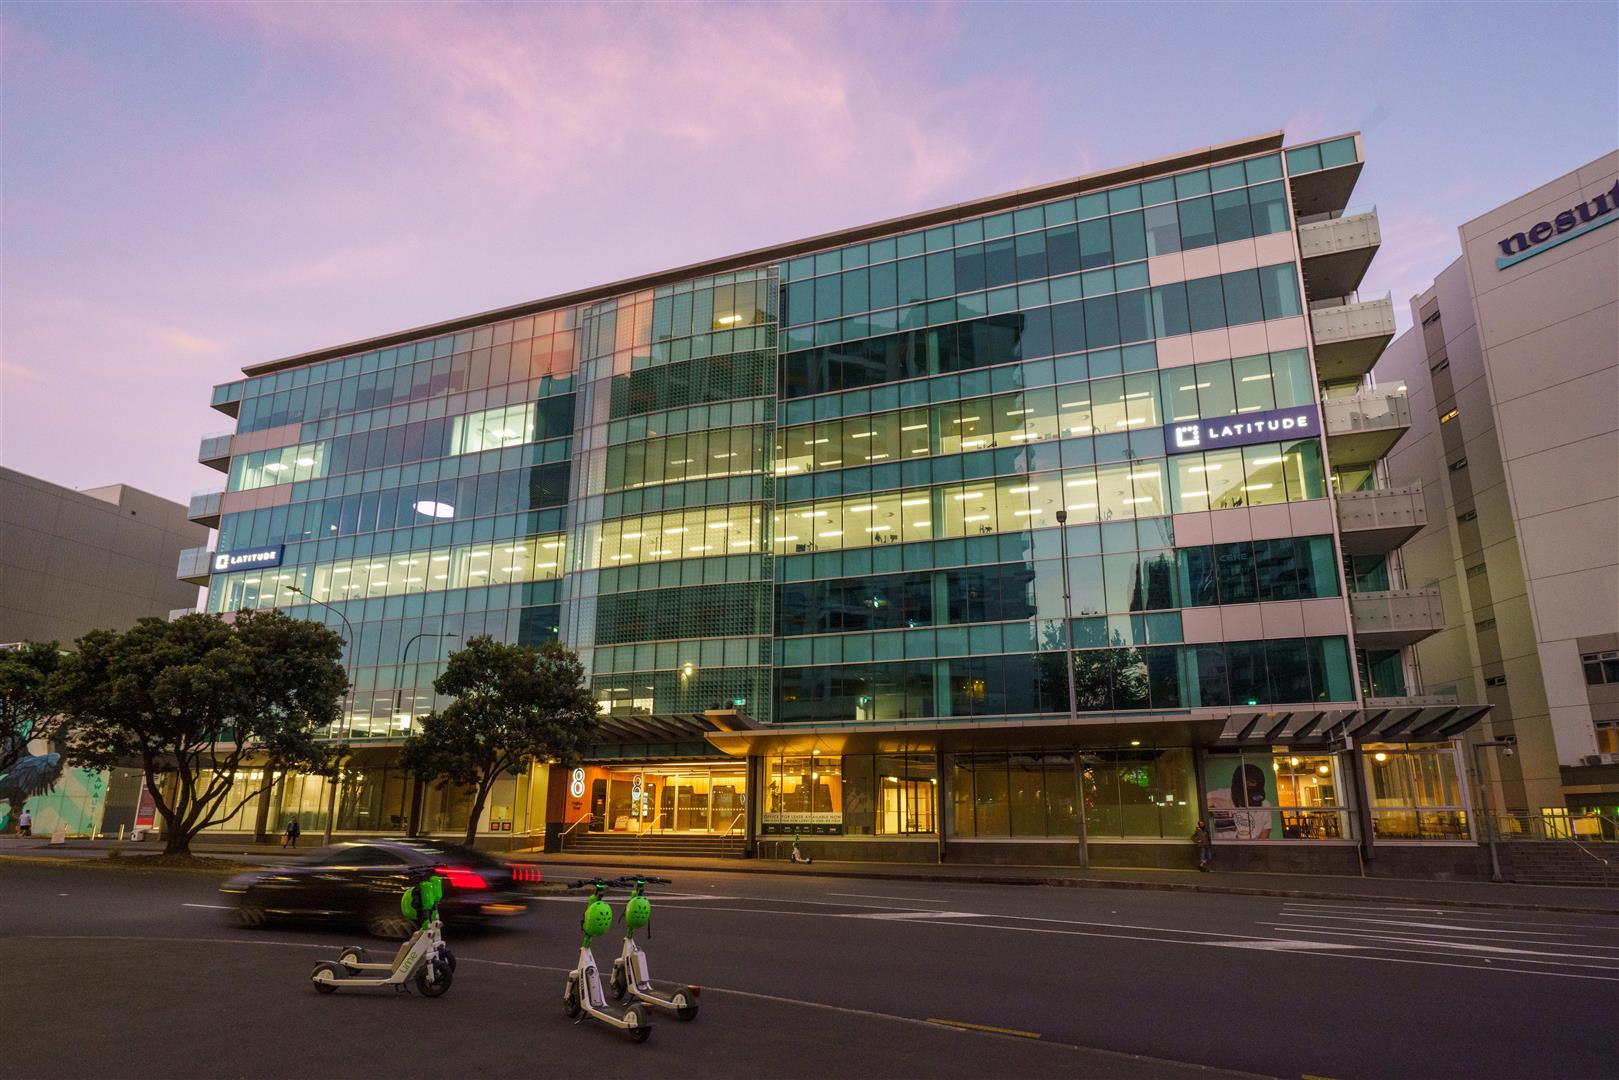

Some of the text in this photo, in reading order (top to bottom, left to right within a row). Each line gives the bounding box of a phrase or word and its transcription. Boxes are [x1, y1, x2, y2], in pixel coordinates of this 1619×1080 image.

[1208, 416, 1309, 438] LATITUDE
[230, 551, 277, 565] LATITUDE
[571, 767, 585, 798] 8
